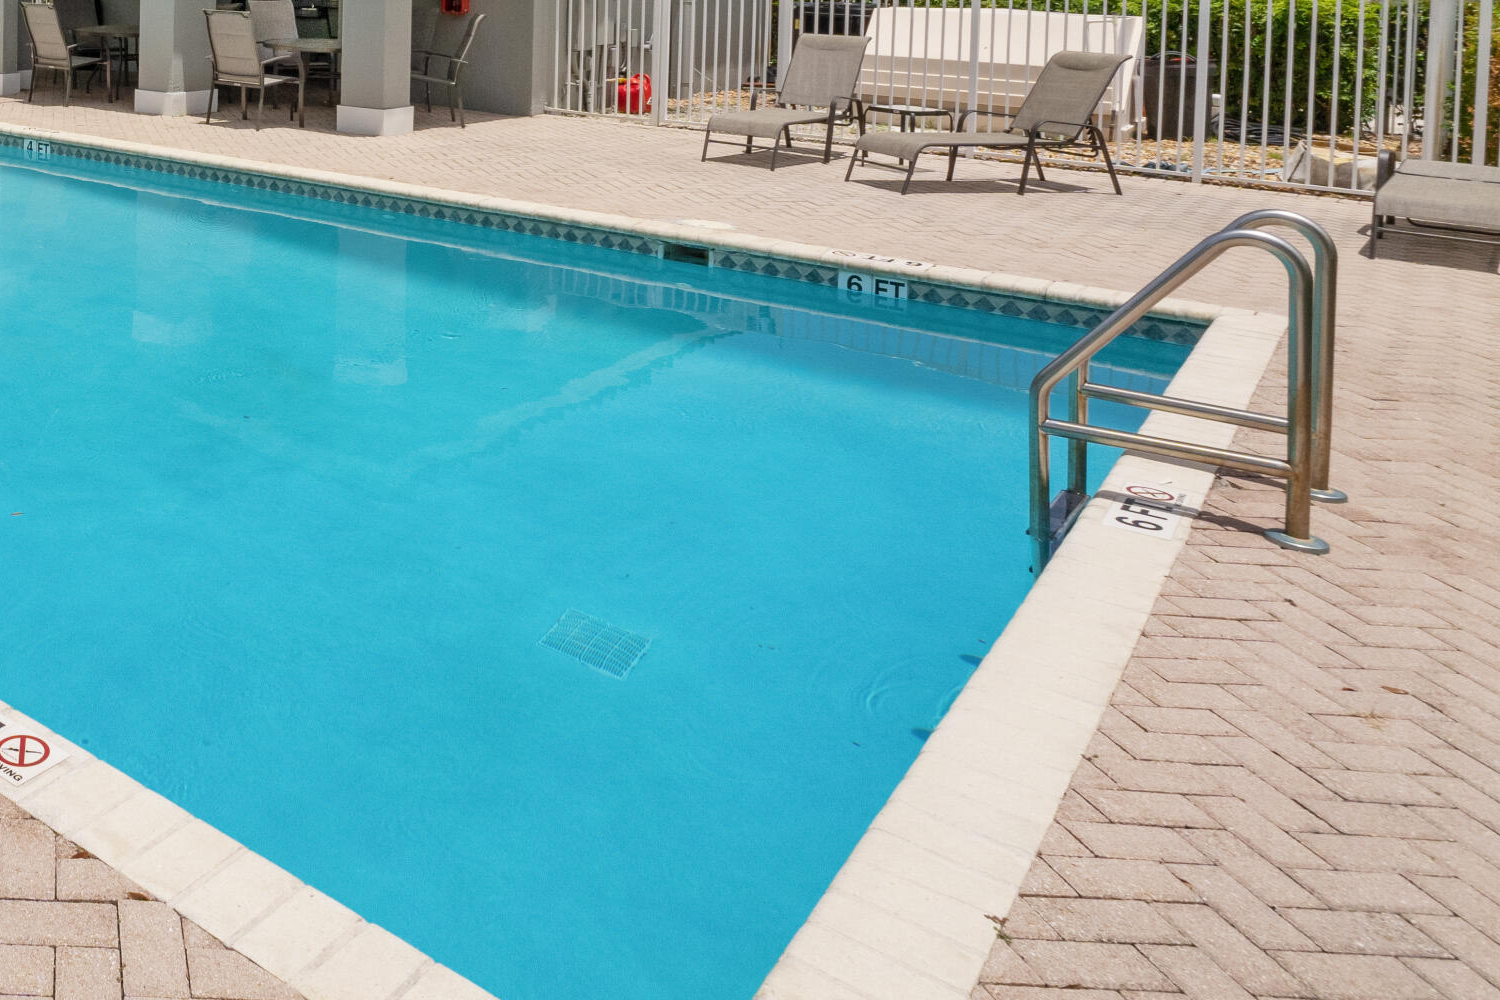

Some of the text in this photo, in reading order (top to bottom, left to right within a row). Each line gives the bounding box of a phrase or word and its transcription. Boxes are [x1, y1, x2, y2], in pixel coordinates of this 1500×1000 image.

[26, 140, 49, 154] 4 FT
[847, 274, 905, 298] 6 FT
[1115, 516, 1163, 531] 6
